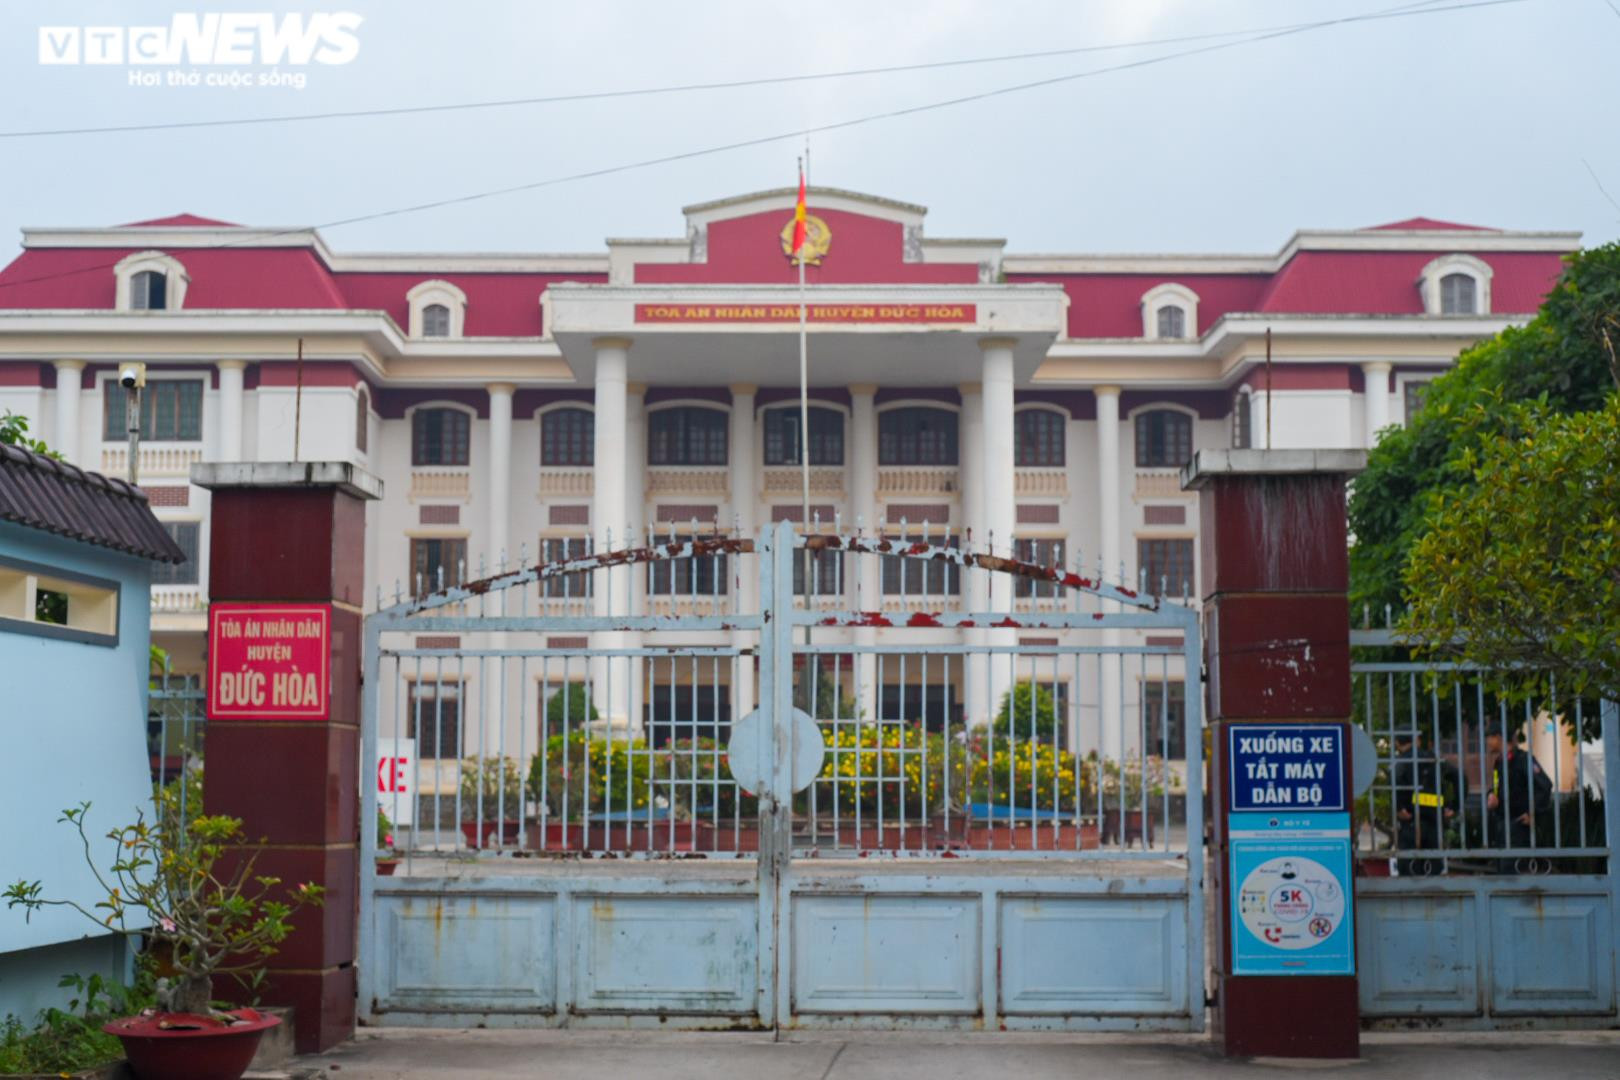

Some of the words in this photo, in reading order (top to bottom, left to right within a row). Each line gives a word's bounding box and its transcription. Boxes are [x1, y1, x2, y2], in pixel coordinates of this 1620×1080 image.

[220, 619, 241, 638] TÒA
[244, 618, 260, 638] ÁN
[263, 618, 294, 638] NHÂN
[297, 618, 321, 638] DÂN
[247, 642, 292, 663] HUYỆN
[220, 664, 267, 706] ĐỨC
[272, 665, 319, 706] HÒA
[1240, 731, 1304, 754] XUỐNG
[1309, 737, 1334, 753] XE
[1245, 756, 1279, 779] TẮT
[1284, 759, 1326, 779] MÁY
[1252, 781, 1292, 804] DẪN
[1297, 783, 1323, 806] BỘ
[1281, 889, 1302, 903] 5K
